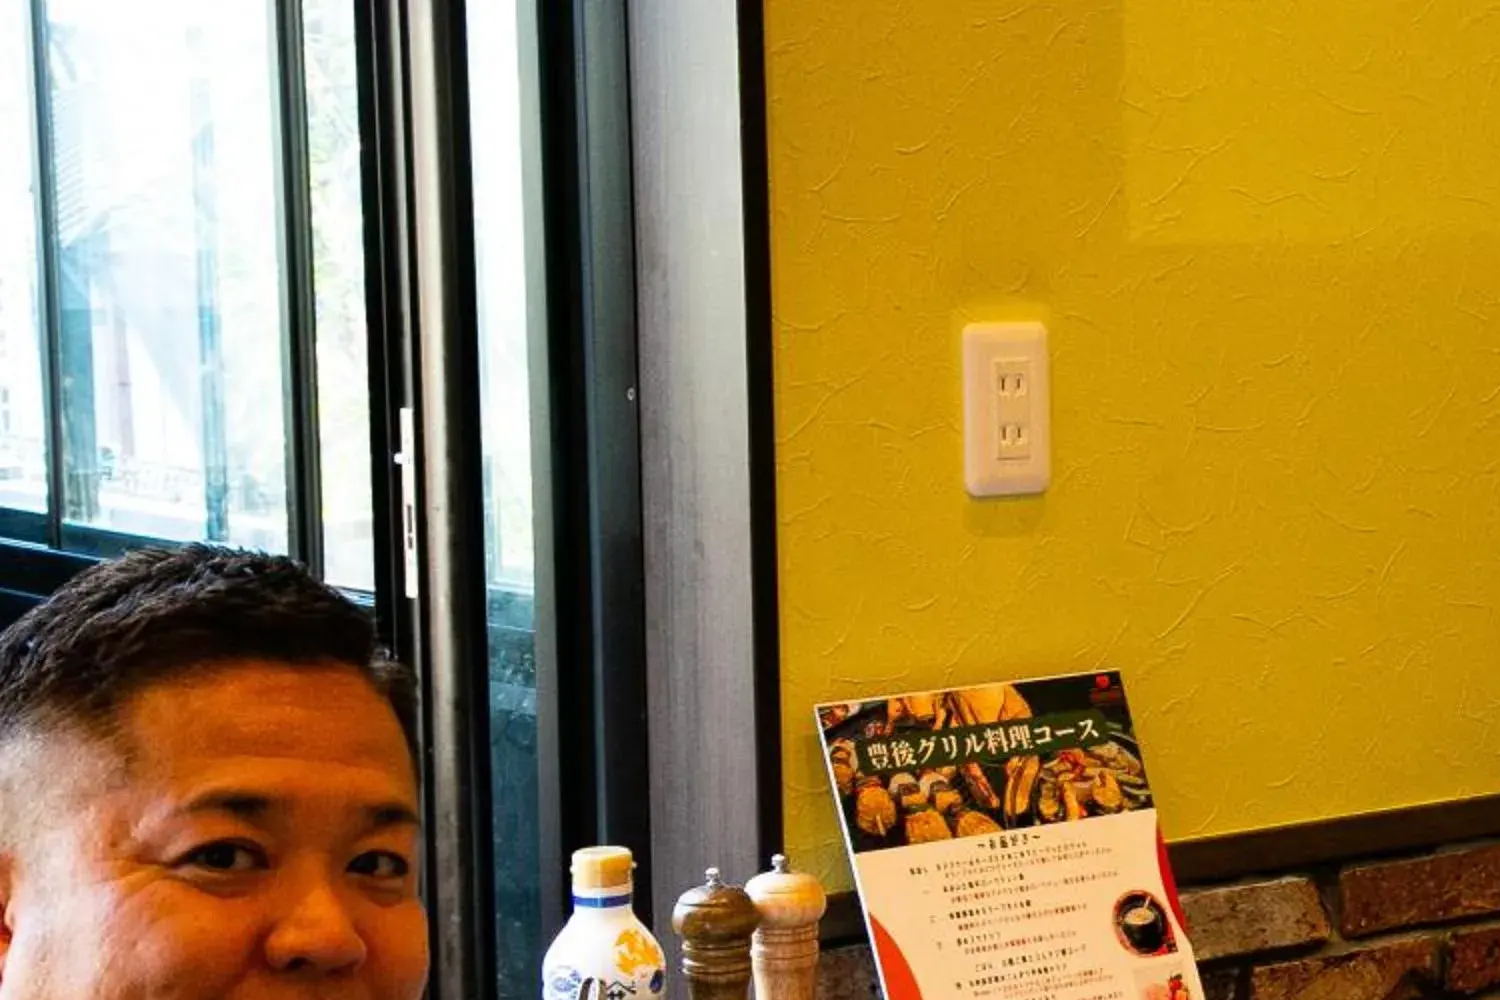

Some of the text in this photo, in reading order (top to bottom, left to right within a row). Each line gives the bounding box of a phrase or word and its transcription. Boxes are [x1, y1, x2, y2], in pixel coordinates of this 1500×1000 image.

[868, 718, 1099, 770] 豊後グリル料理コース
